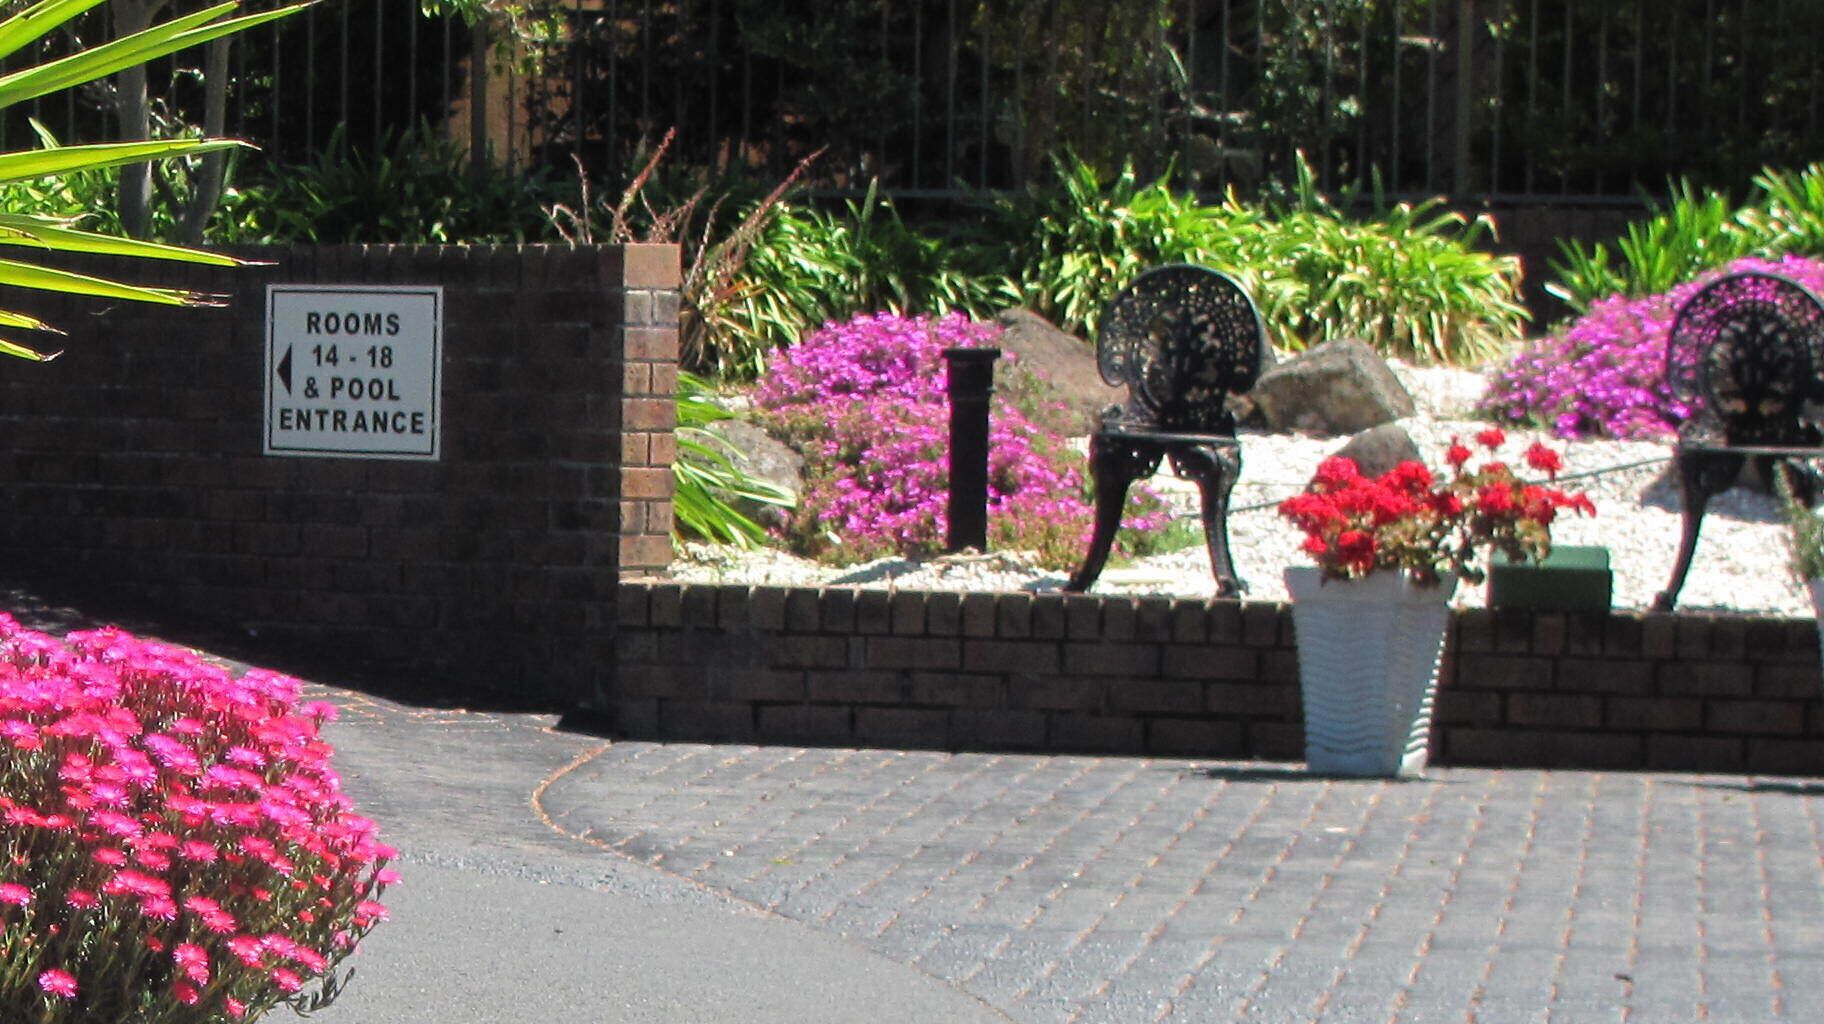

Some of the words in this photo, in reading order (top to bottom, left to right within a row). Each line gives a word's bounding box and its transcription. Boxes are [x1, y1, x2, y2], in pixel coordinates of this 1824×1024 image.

[307, 312, 400, 336] ROOMS
[313, 344, 338, 367] 14
[367, 346, 393, 368] 18
[304, 376, 320, 399] &
[330, 376, 400, 401] POOL
[279, 408, 424, 434] ENTRANCE
